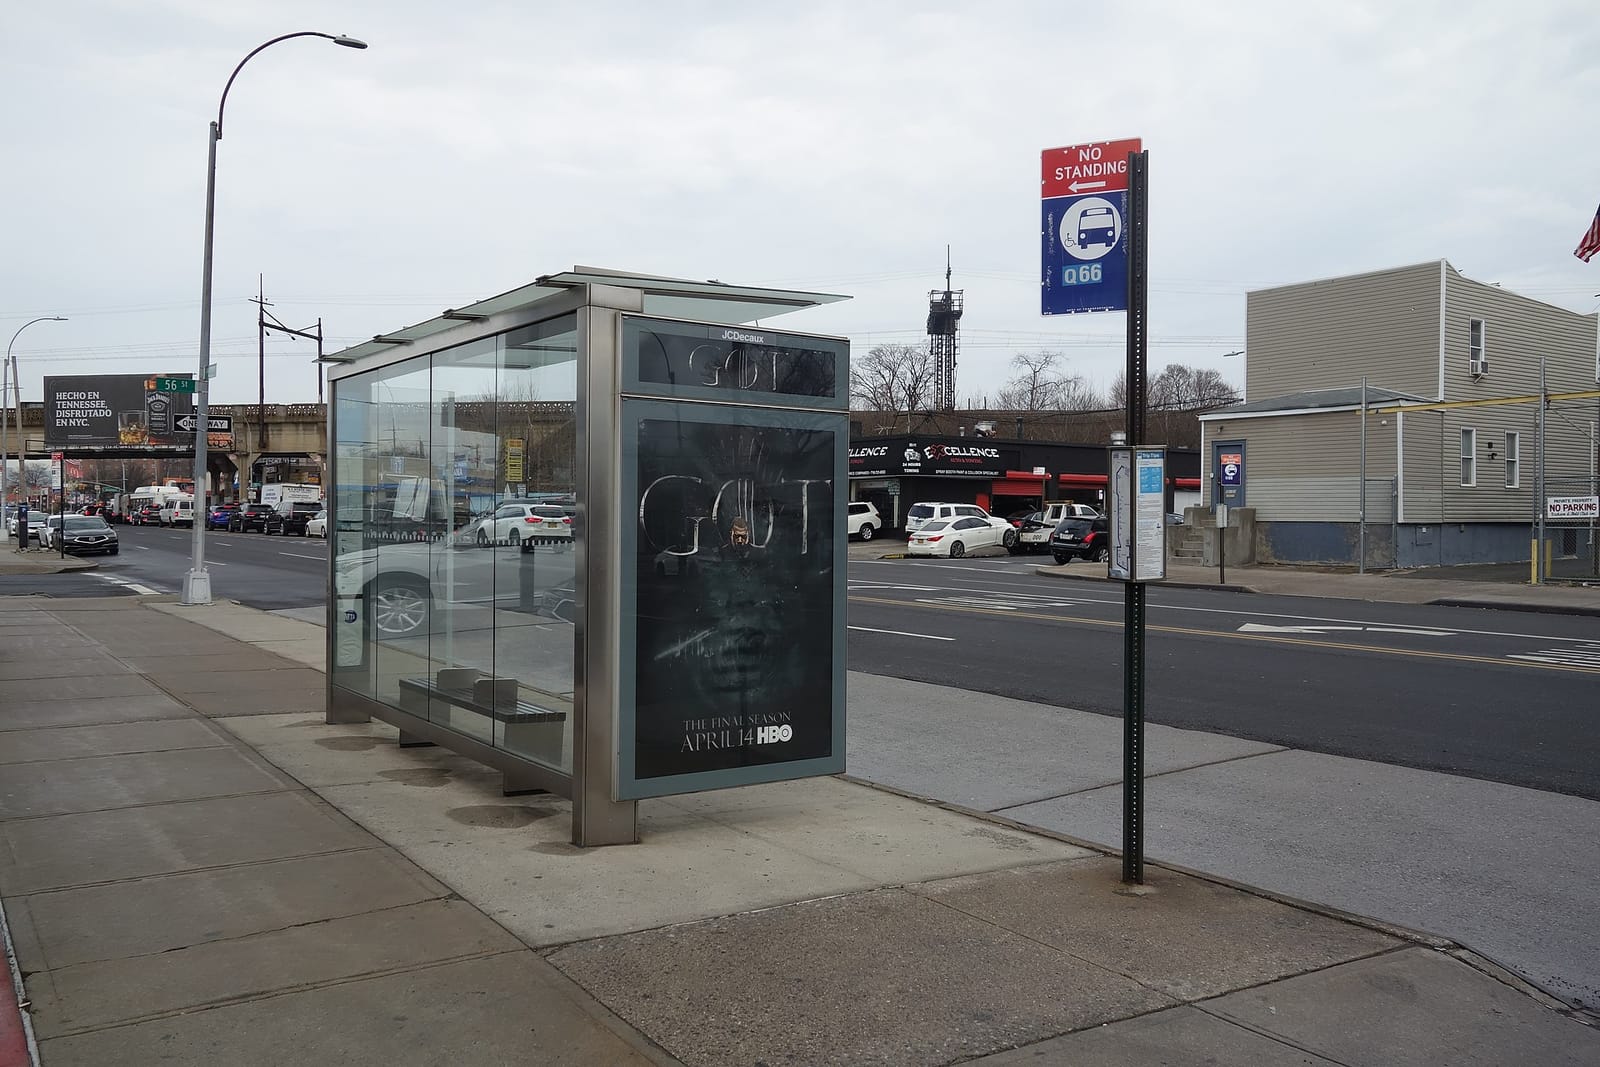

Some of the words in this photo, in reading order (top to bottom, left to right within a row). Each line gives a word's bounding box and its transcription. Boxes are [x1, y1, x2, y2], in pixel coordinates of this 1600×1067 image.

[1079, 147, 1102, 162] NO
[1055, 160, 1127, 181] STANDING
[1064, 263, 1102, 284] Q66
[722, 330, 764, 344] JCDecaux
[165, 380, 177, 390] 56
[56, 392, 86, 400] HECHO
[87, 391, 100, 400] EN
[56, 400, 108, 410] TENNESSEE,
[56, 409, 112, 418] DISFRUTADO
[56, 418, 68, 427] EN
[69, 418, 90, 427] NYC.
[208, 420, 225, 428] WAY
[924, 444, 1000, 460] EXCELLENCE
[1550, 504, 1561, 512] NO
[1562, 503, 1597, 512] PARKING
[640, 474, 832, 556] GOT
[684, 719, 706, 731] THE
[712, 715, 744, 729] FINAL
[748, 711, 792, 725] SEASON
[680, 730, 735, 753] APRIL
[737, 727, 754, 747] 14
[756, 724, 793, 745] HBO
